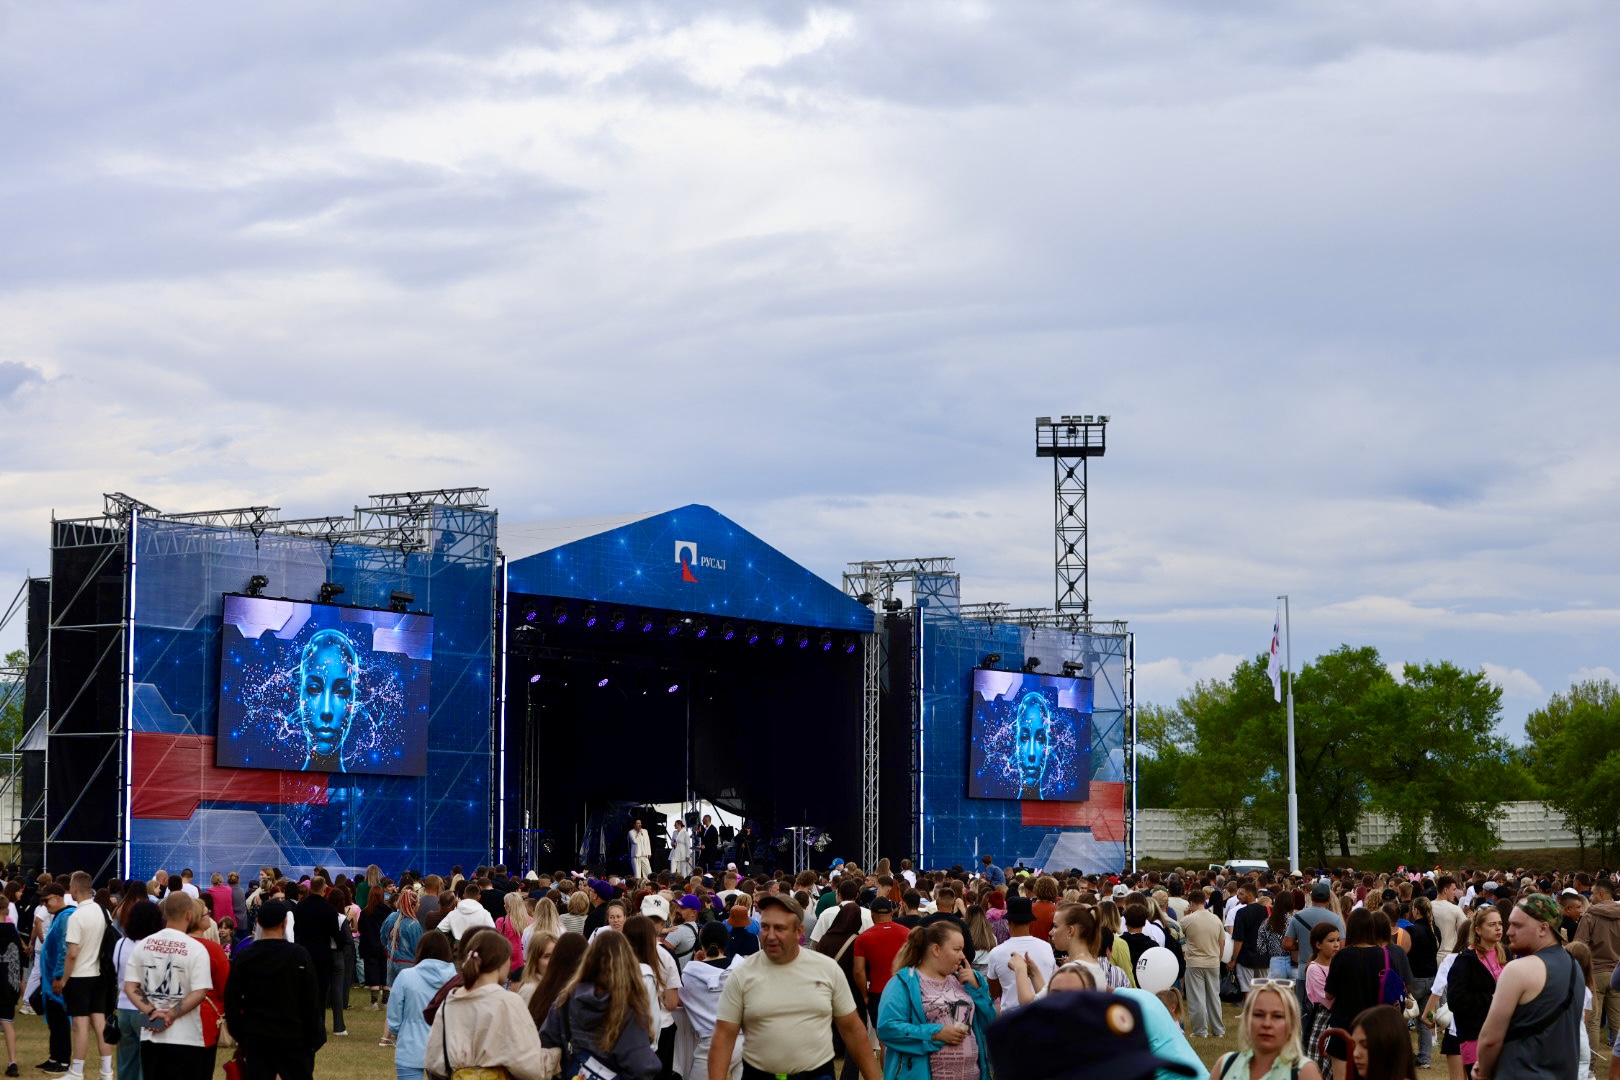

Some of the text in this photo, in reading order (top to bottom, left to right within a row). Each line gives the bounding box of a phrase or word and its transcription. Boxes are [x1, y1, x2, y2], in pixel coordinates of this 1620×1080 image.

[701, 556, 726, 570] РУСАЛ
[146, 938, 186, 949] ENDLESS
[143, 944, 188, 956] HORIZONS
